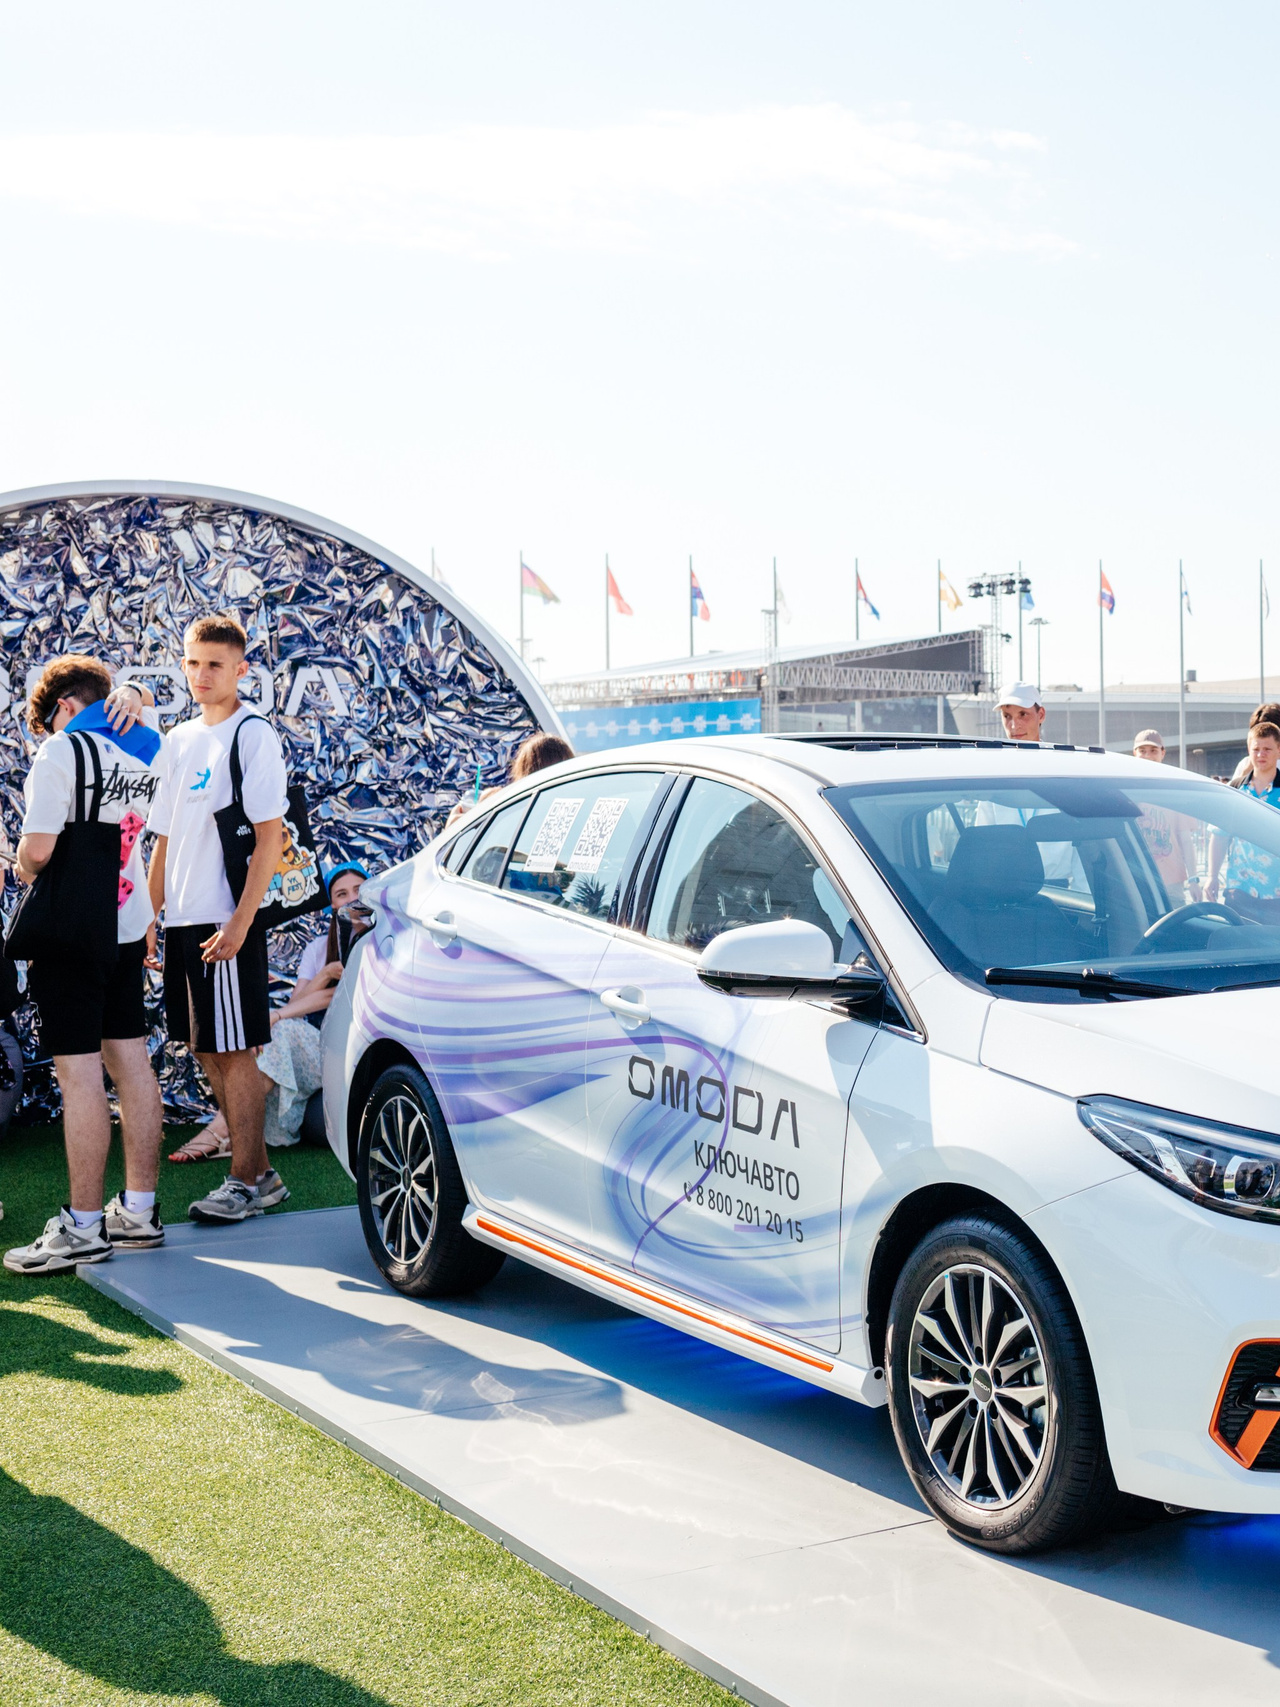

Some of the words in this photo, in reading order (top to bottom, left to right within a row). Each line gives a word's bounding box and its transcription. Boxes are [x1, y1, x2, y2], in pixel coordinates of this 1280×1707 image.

[628, 1055, 800, 1149] OMODA
[694, 1139, 800, 1201] КЛЮЧАВТО
[696, 1184, 704, 1206] 8
[708, 1188, 733, 1217] 800
[736, 1199, 761, 1227] 201
[765, 1209, 783, 1235] 20
[786, 1218, 804, 1243] 15
